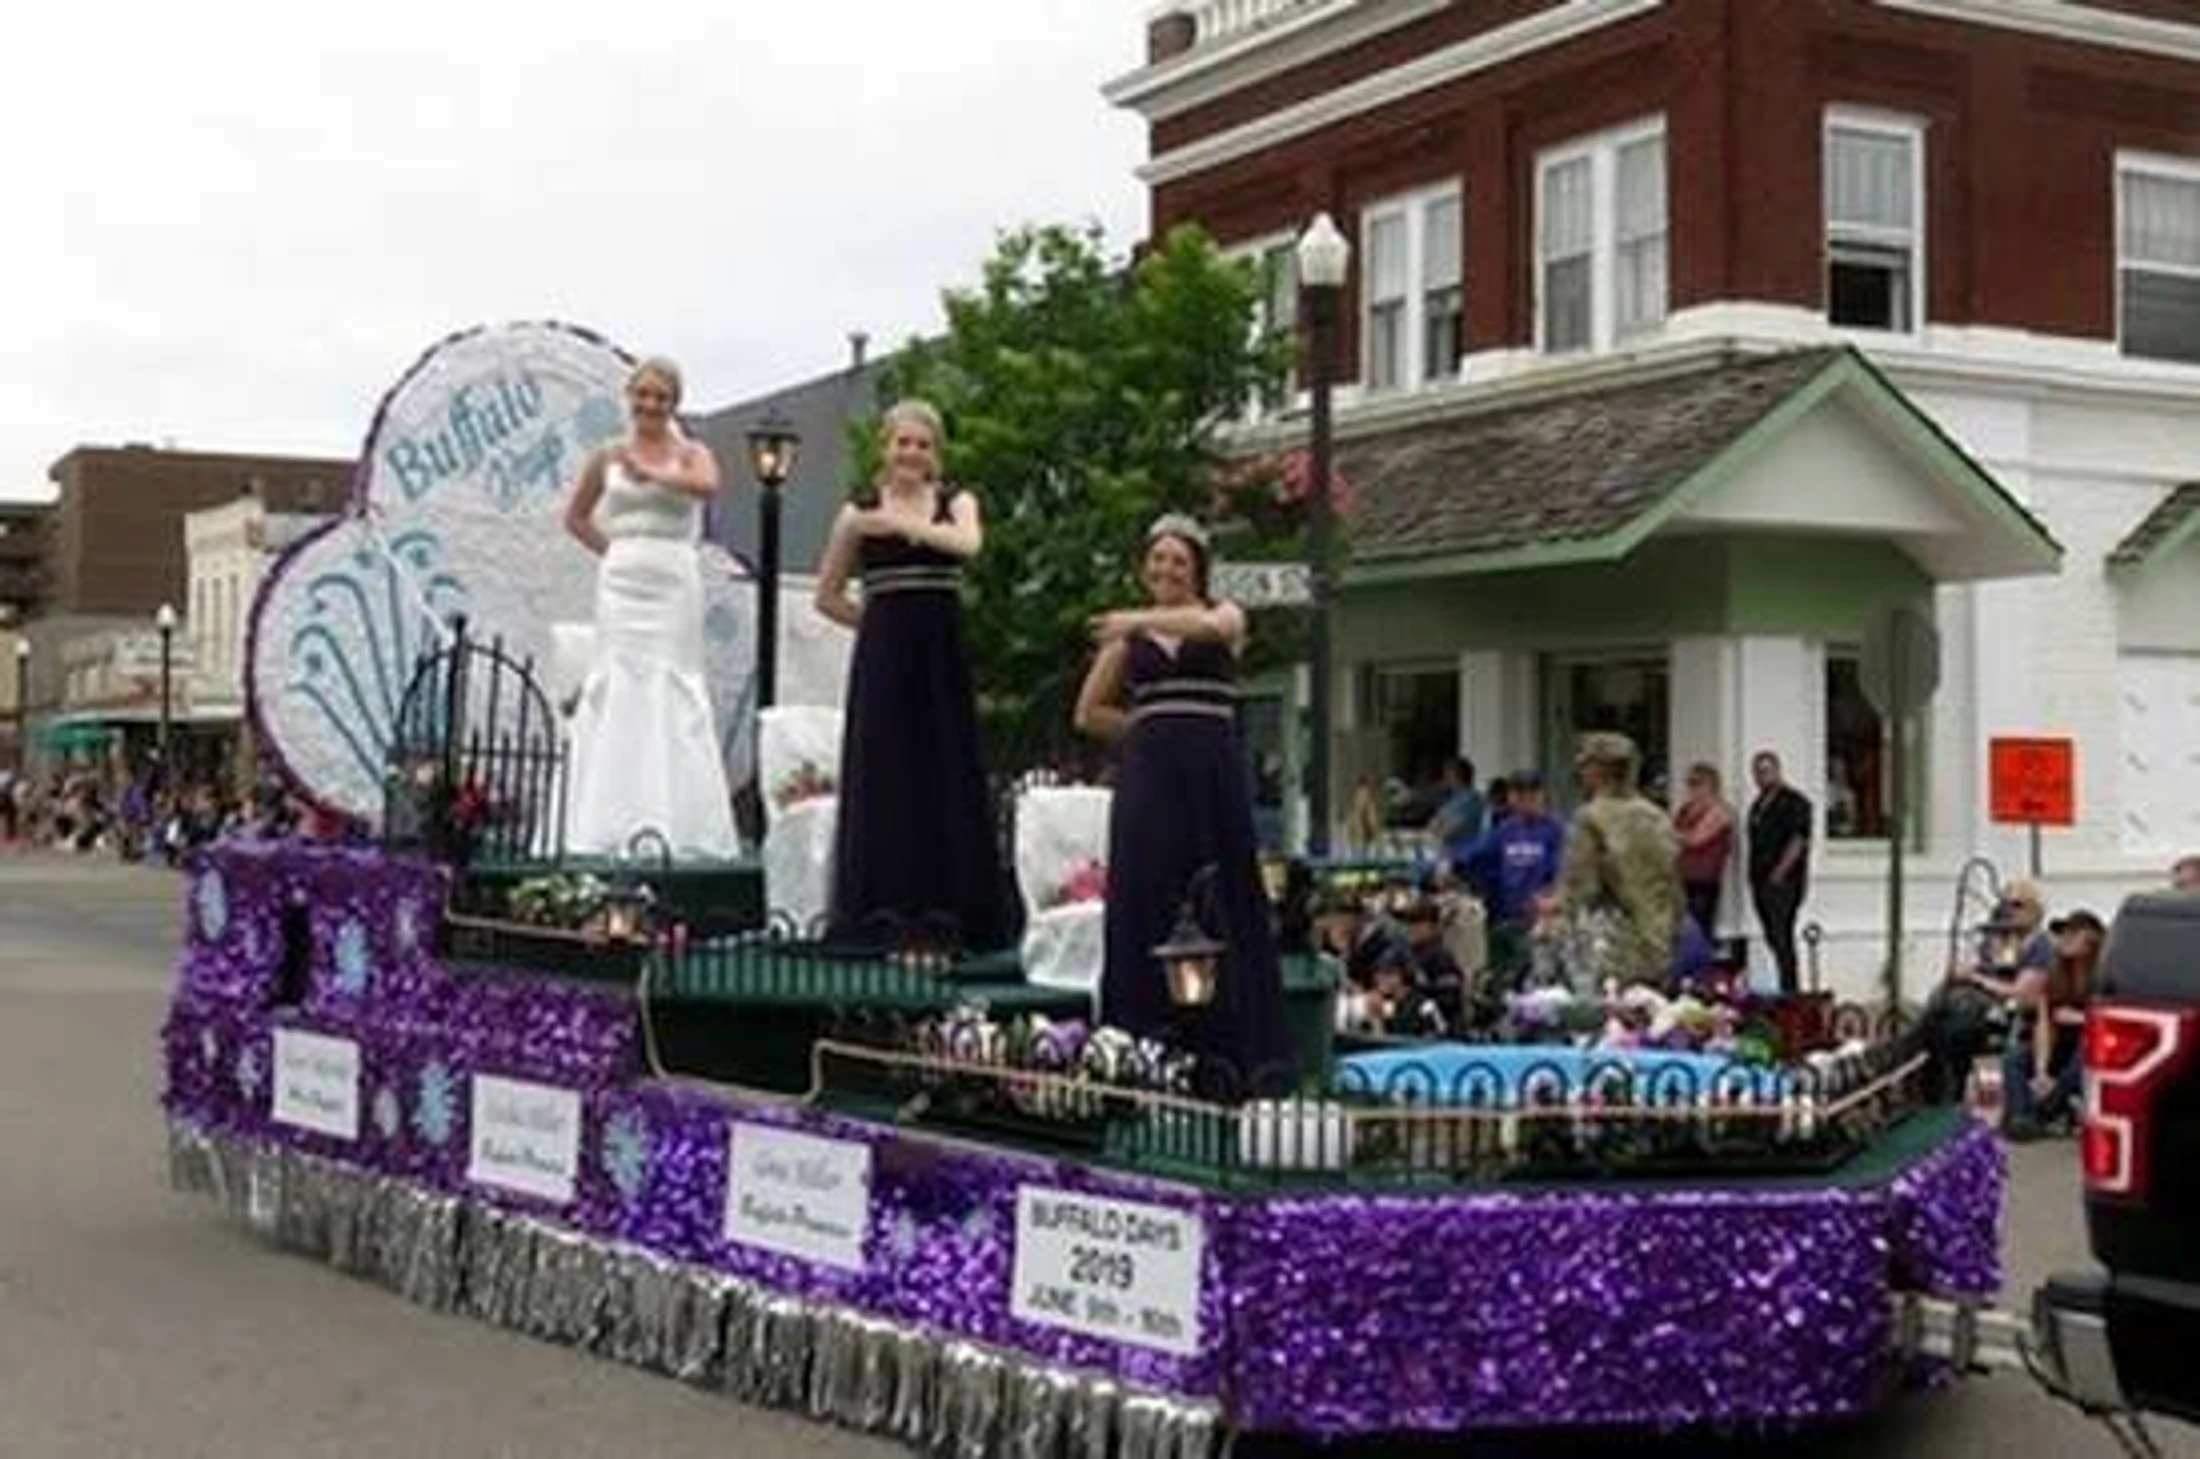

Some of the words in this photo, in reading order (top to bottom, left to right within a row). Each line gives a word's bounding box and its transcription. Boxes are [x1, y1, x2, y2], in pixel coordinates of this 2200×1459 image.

[387, 376, 542, 500] Buffalo
[1031, 1199, 1123, 1240] BUFFALO
[1125, 1212, 1182, 1252] DAYS
[1070, 1244, 1134, 1290] 2019
